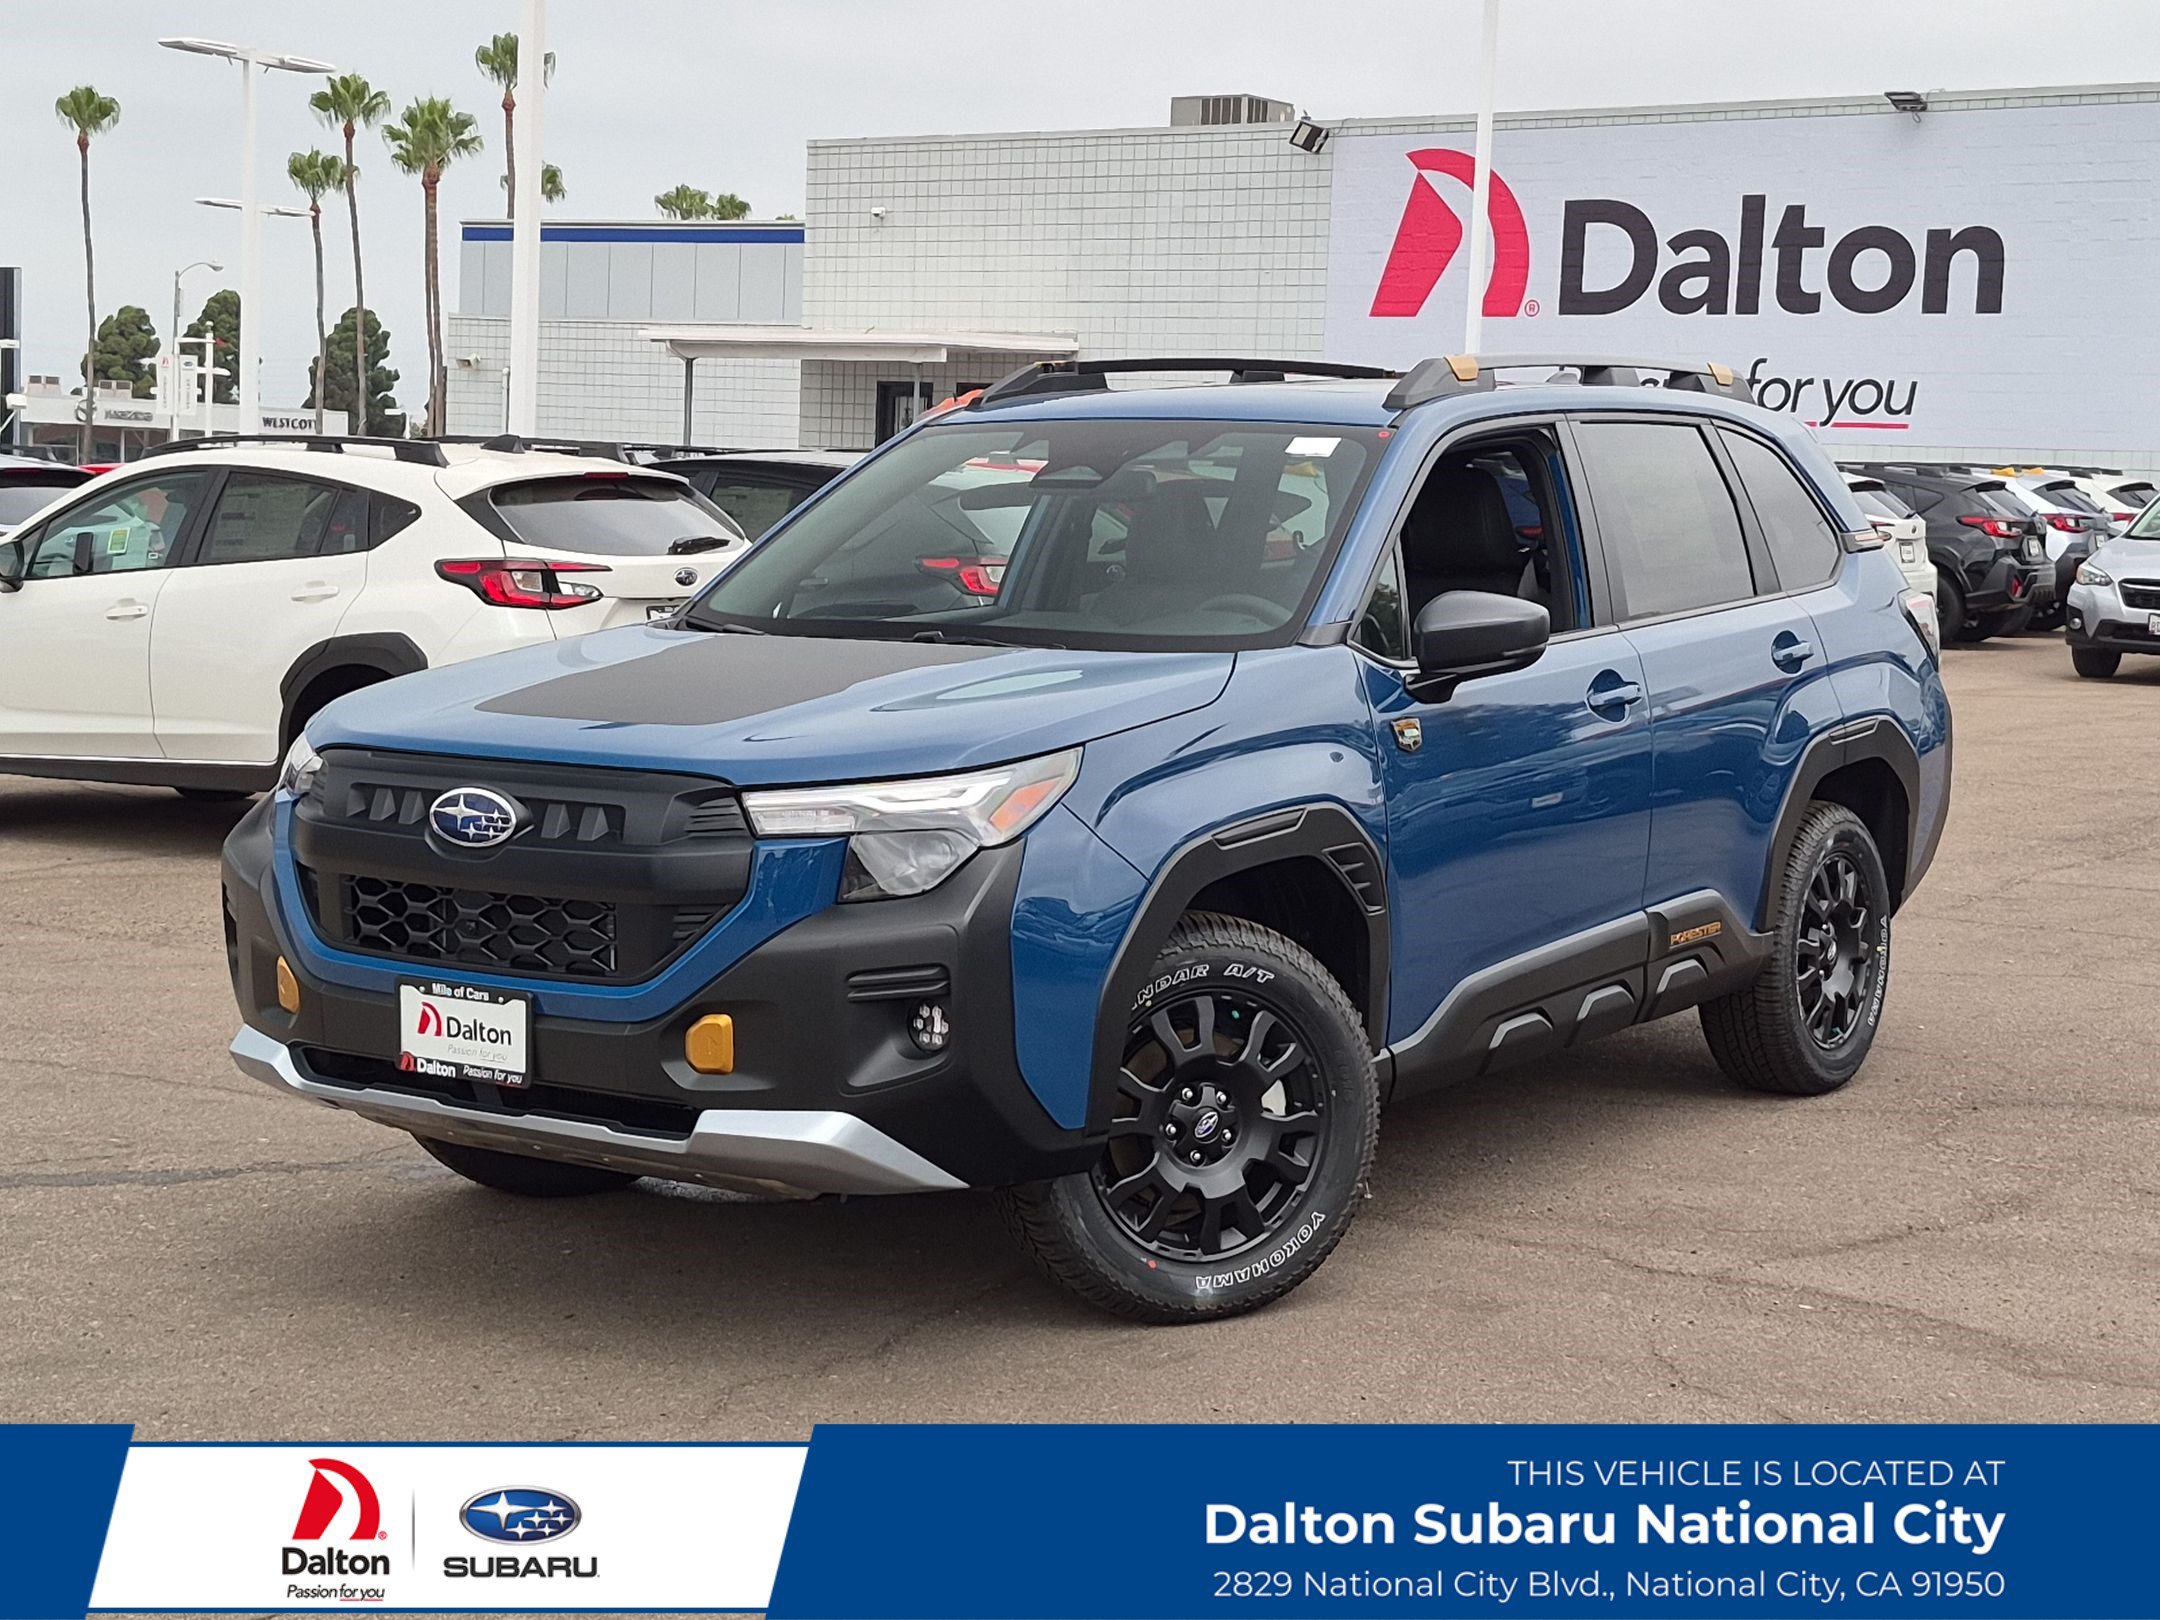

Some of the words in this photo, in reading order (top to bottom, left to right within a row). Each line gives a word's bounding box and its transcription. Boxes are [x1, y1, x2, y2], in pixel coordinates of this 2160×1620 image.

[1559, 194, 2005, 316] Dalton
[1747, 358, 1814, 413] for
[1819, 378, 1918, 427] you
[453, 985, 465, 997] of
[466, 987, 490, 1001] Cars
[1131, 963, 1210, 1011] NDAR
[1223, 963, 1275, 984] A/T
[446, 1016, 512, 1046] Dalton
[416, 1057, 456, 1078] Dalton
[463, 1064, 493, 1079] Passion
[494, 1069, 506, 1080] for
[507, 1073, 523, 1085] you
[1195, 1211, 1326, 1289] YOKOHAMA
